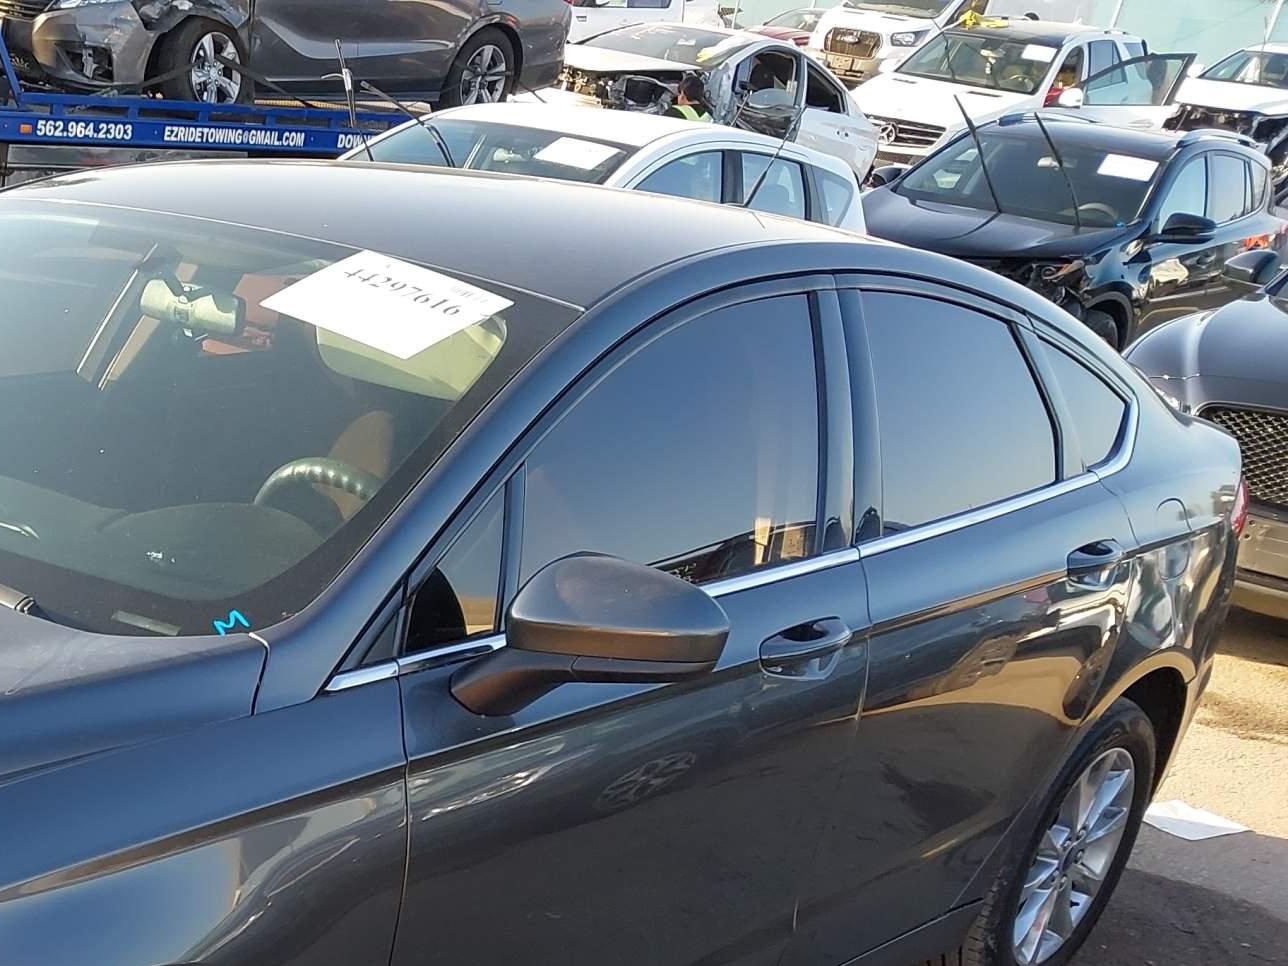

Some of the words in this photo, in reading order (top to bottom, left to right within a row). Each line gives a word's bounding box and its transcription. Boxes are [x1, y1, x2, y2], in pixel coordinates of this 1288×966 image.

[36, 119, 133, 140] 562.964.2303
[163, 125, 305, 148] EZRIDETOWING@GMAIL.COM
[344, 268, 461, 316] 44297616
[213, 609, 250, 637] M
